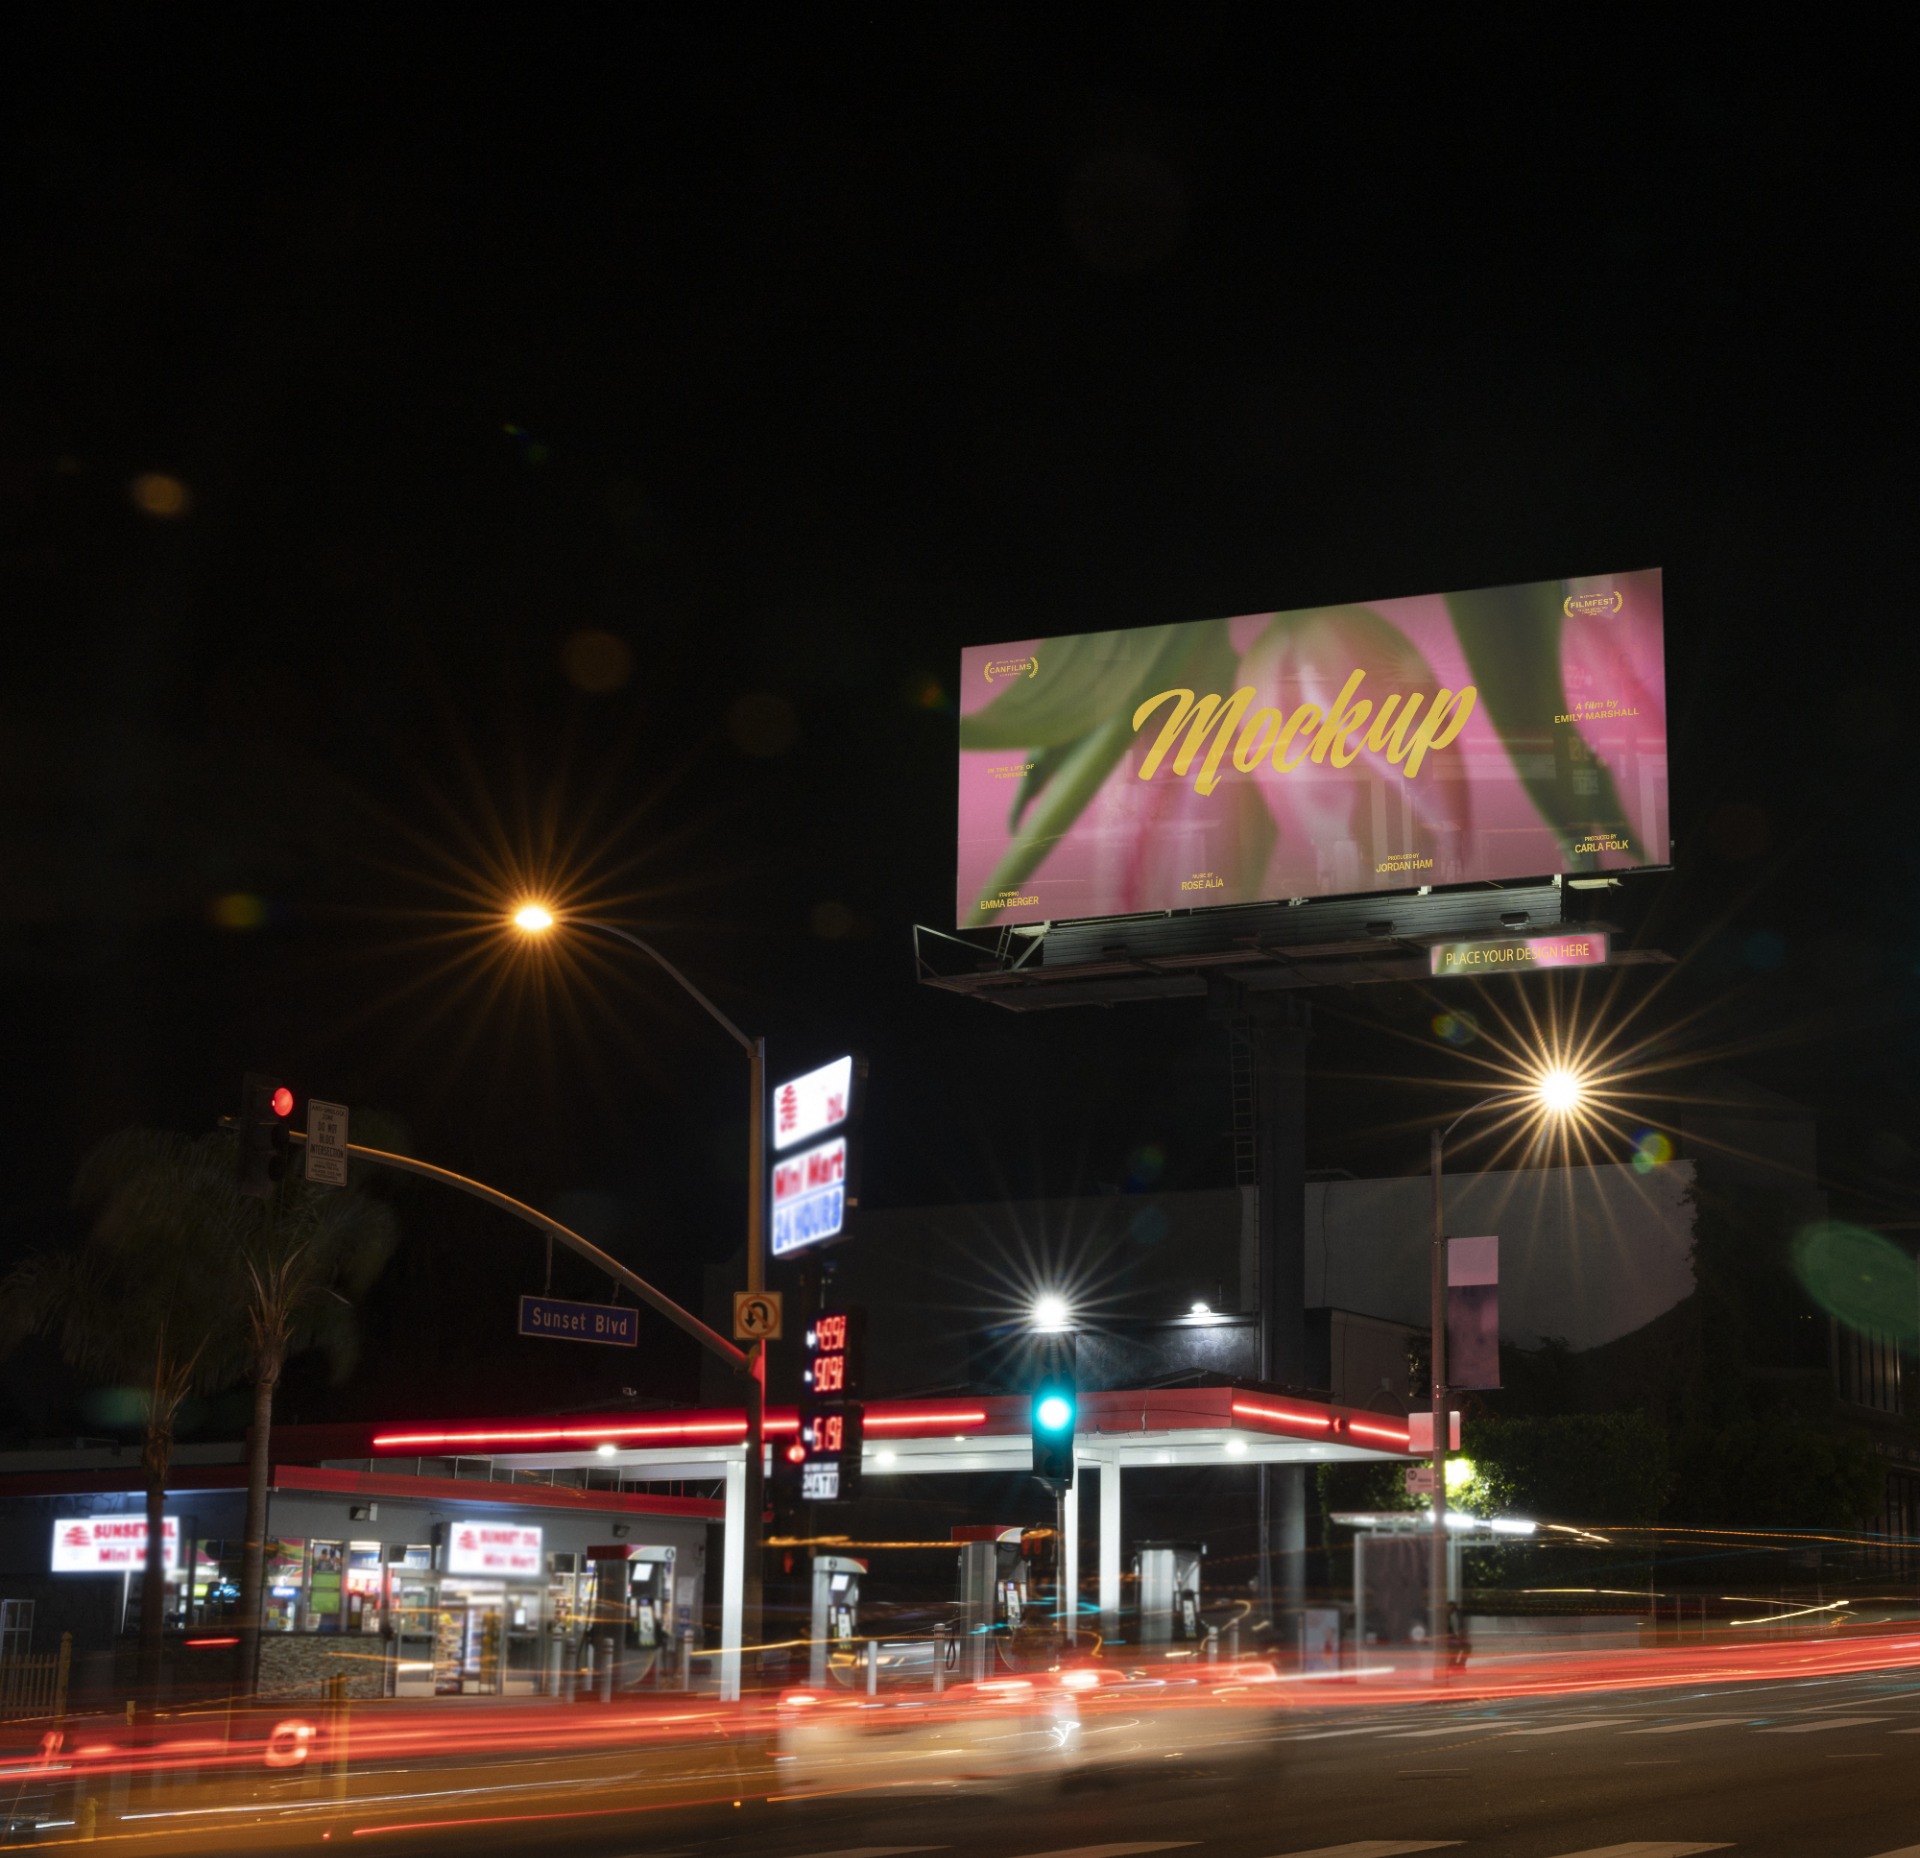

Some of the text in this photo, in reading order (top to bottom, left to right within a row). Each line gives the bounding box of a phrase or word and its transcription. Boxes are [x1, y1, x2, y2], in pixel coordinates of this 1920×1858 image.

[1570, 597, 1615, 609] FILMFEST
[989, 663, 1032, 675] CANFILMS
[1584, 700, 1604, 709] film
[1606, 699, 1619, 708] by
[1554, 707, 1640, 724] EMILY MARSHALL
[1132, 668, 1478, 797] Mockup
[1574, 839, 1629, 853] CARLA FOLK
[1375, 858, 1433, 873] JORDAN HAM
[1181, 880, 1204, 891] ROSE
[980, 896, 1039, 910] EMMA BERGER
[1446, 943, 1590, 965] PLACE YOUR DESIGN HERE
[532, 1306, 628, 1336] Sunset Blvd
